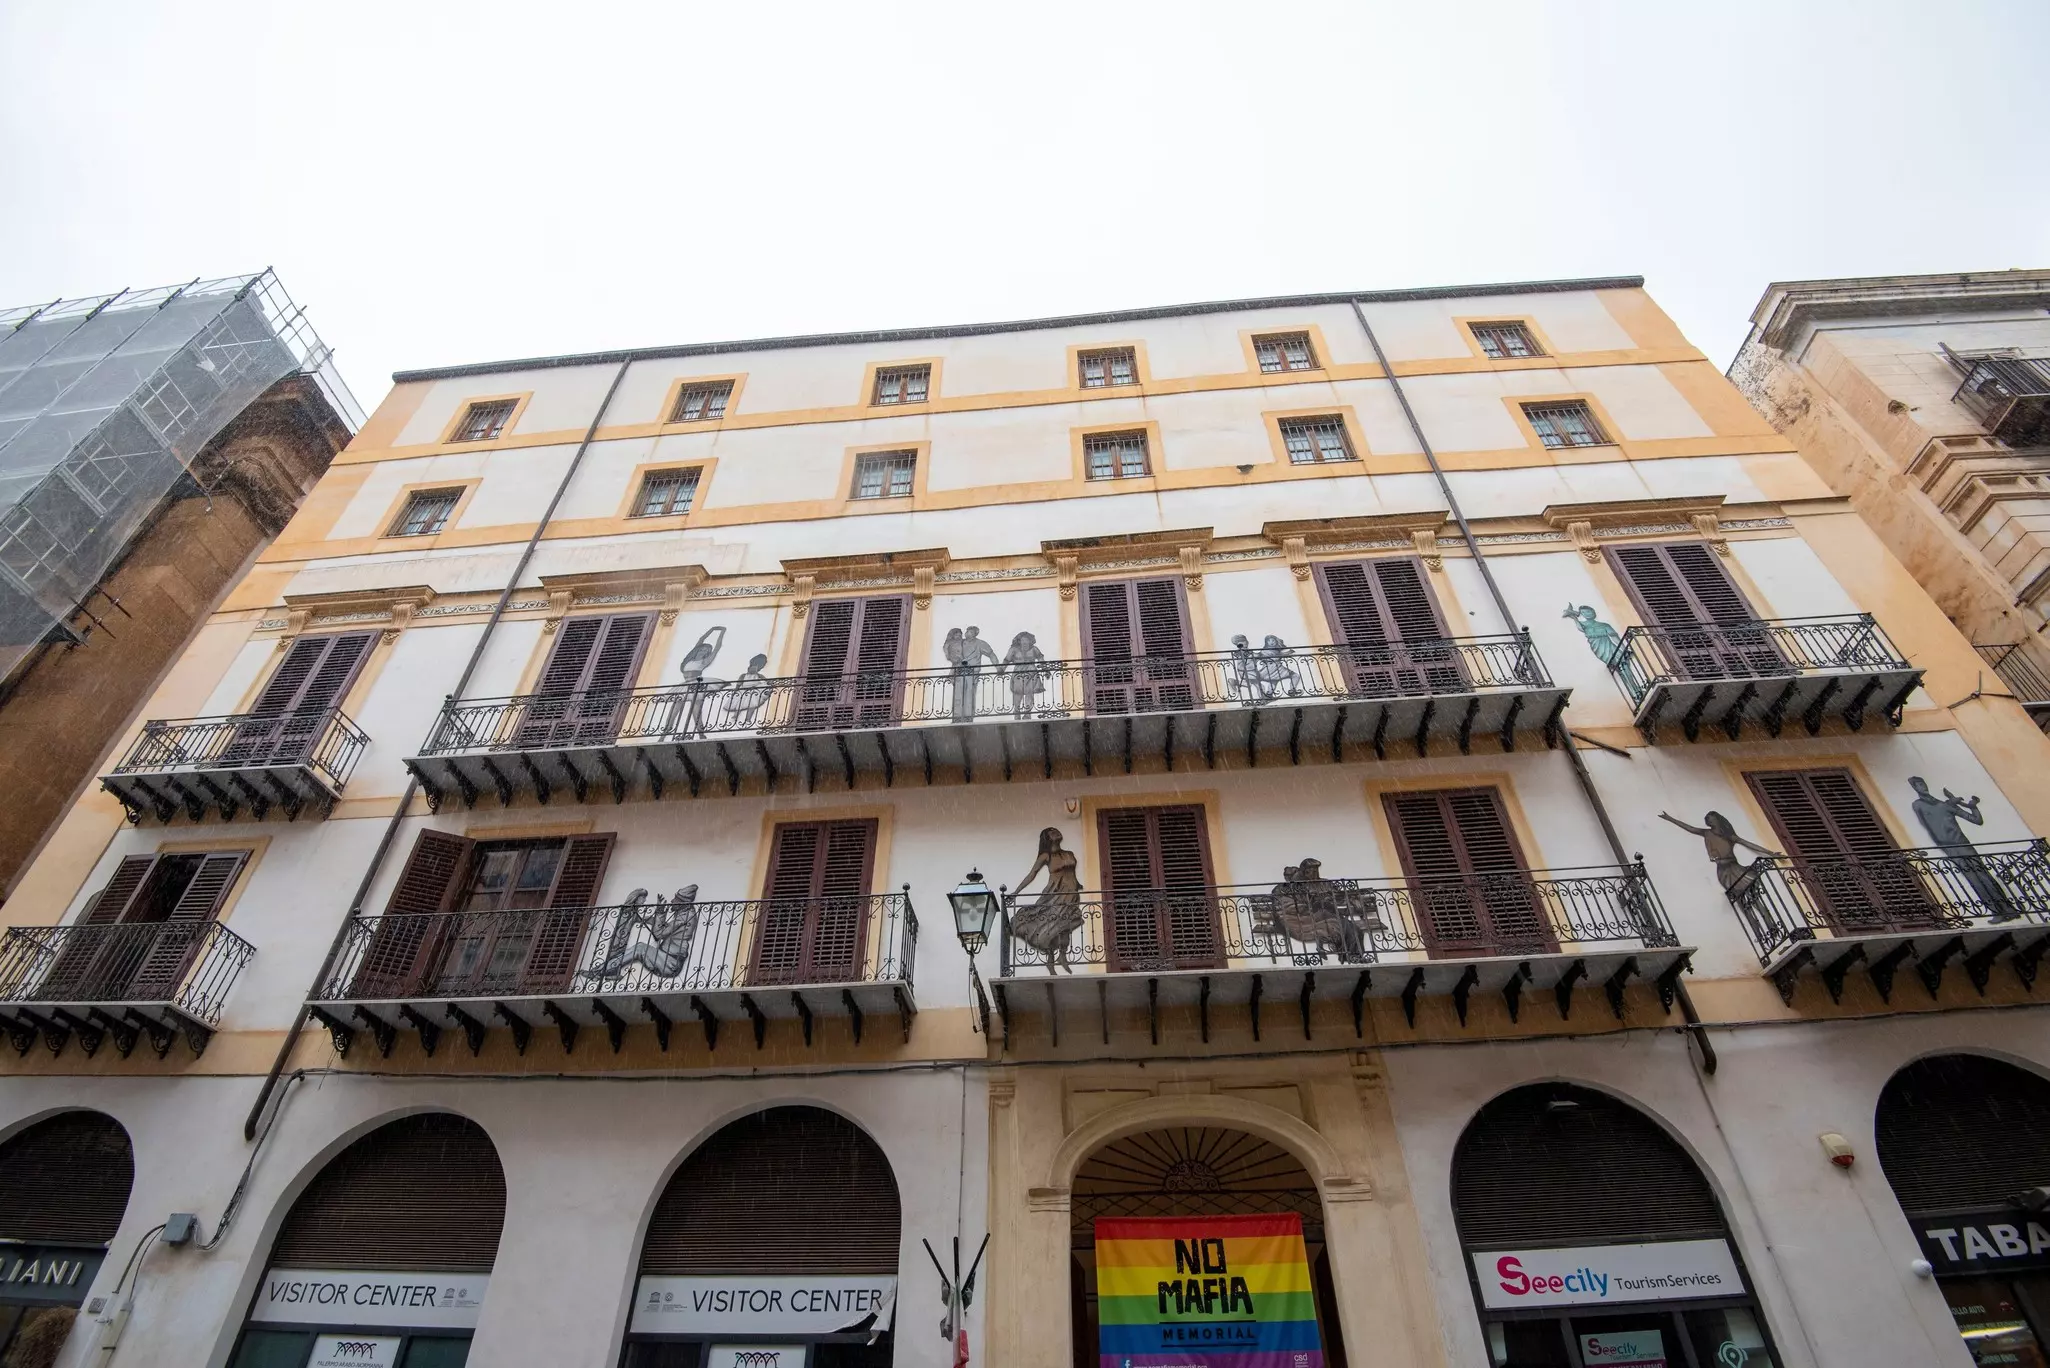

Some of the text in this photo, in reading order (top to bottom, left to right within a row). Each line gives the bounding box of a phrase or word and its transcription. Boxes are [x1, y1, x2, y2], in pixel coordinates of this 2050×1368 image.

[1174, 1238, 1228, 1275] NO
[1925, 1221, 2050, 1261] TABA
[1497, 1256, 1608, 1297] Seecily
[270, 1281, 437, 1307] VISITOR CENTER
[692, 1289, 883, 1312] VISITOR CENTER
[1158, 1276, 1255, 1315] MAFIA
[1162, 1325, 1257, 1341] MEMORIAL
[1587, 1338, 1638, 1356] Seecily
